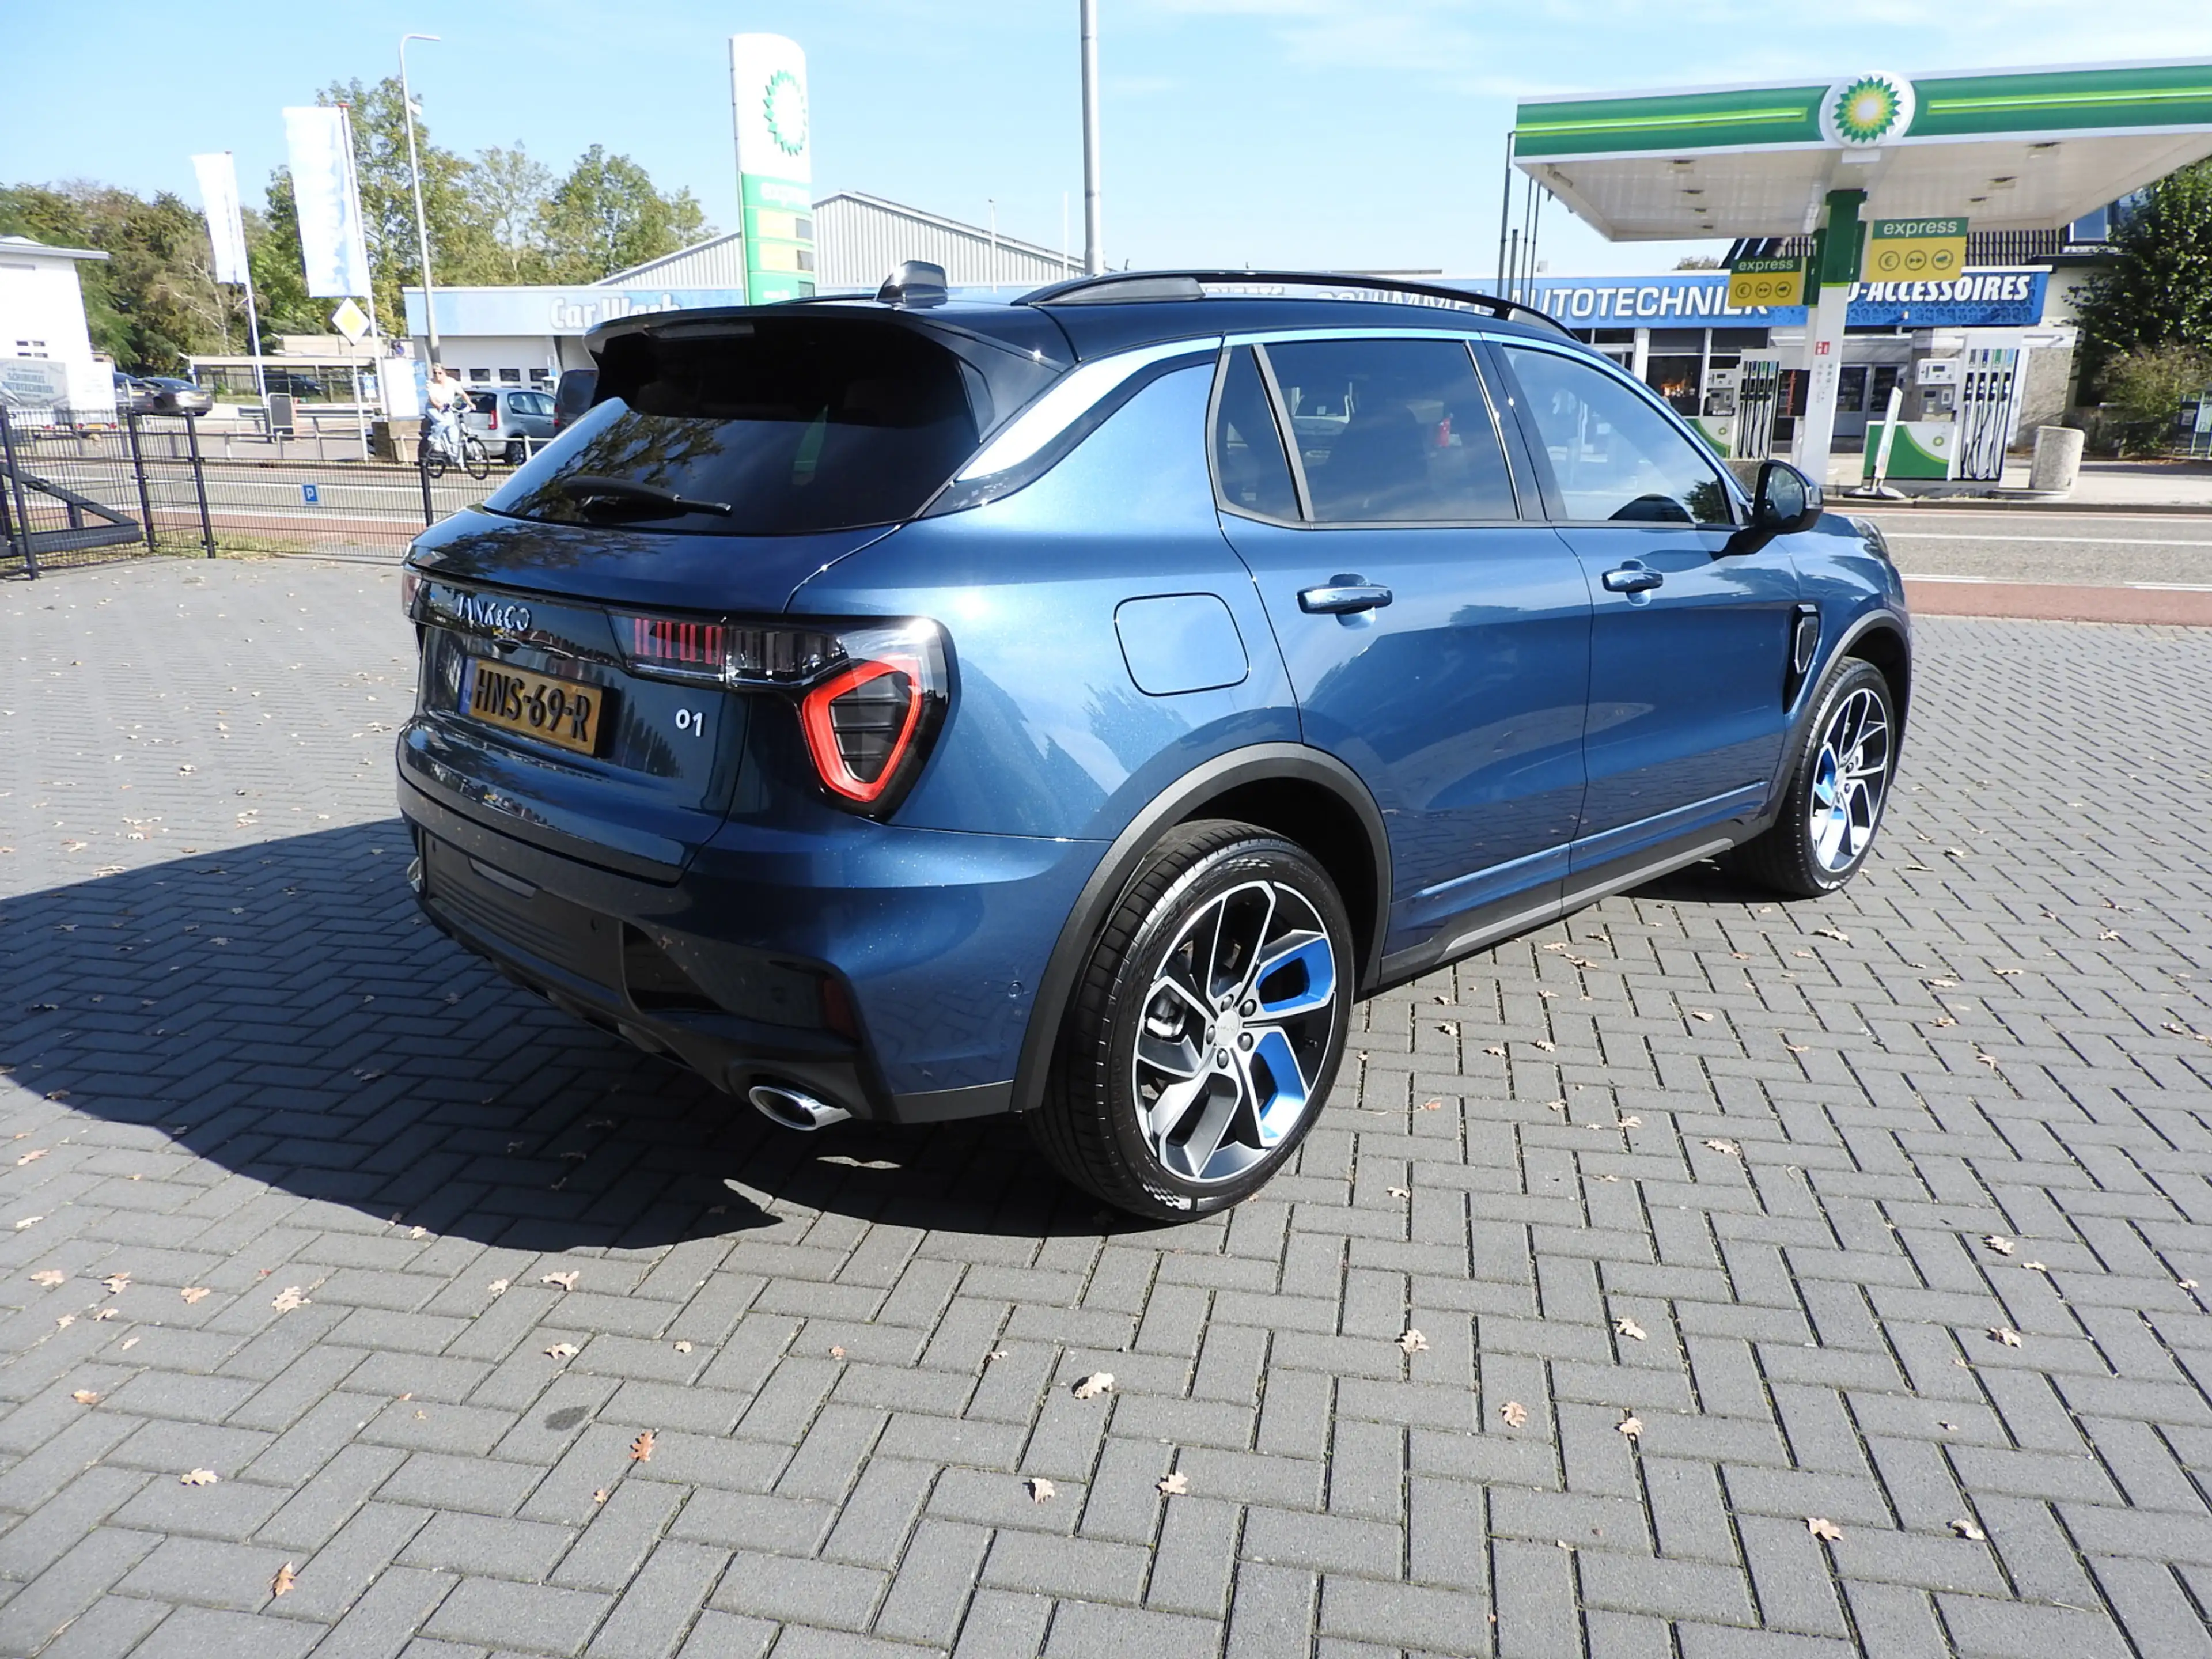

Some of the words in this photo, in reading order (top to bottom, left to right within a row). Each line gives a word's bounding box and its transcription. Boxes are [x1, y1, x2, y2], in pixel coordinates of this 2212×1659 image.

[1883, 220, 1958, 237] express
[1738, 259, 1794, 272] express
[551, 298, 597, 328] Car
[306, 487, 315, 500] P
[475, 669, 592, 742] HNS-69-R
[676, 708, 703, 737] 01
